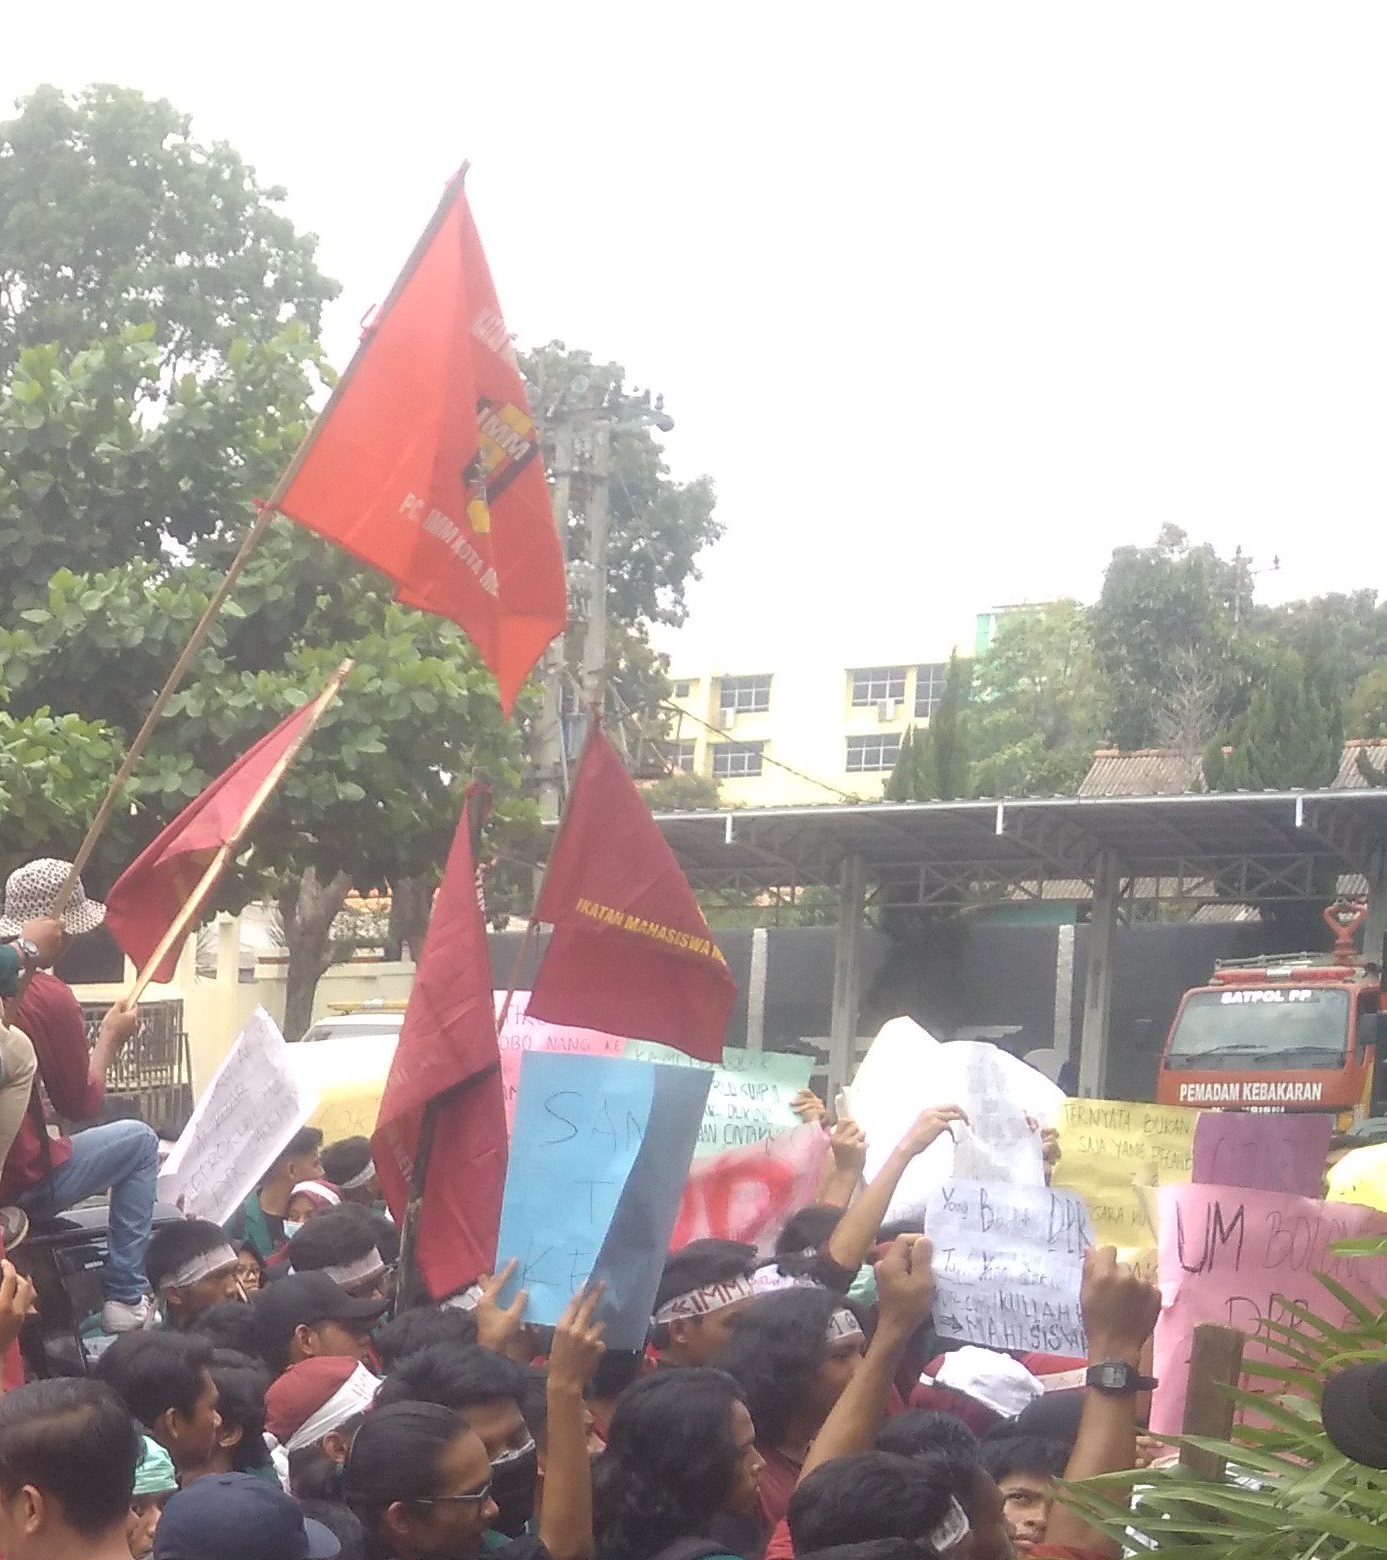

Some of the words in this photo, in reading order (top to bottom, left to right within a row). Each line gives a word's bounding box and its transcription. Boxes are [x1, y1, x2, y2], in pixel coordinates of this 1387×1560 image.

[477, 406, 532, 462] IMM
[575, 897, 625, 926] IKATAN
[623, 915, 711, 955] MAHASISWA
[1221, 990, 1285, 1005] SATPOL
[1288, 989, 1312, 1002] PP
[1179, 1082, 1240, 1102] PEMADAM
[1242, 1082, 1323, 1101] KEBAKARAN
[1064, 1102, 1131, 1132] TERNYATA
[1143, 1112, 1189, 1137] BUKAN
